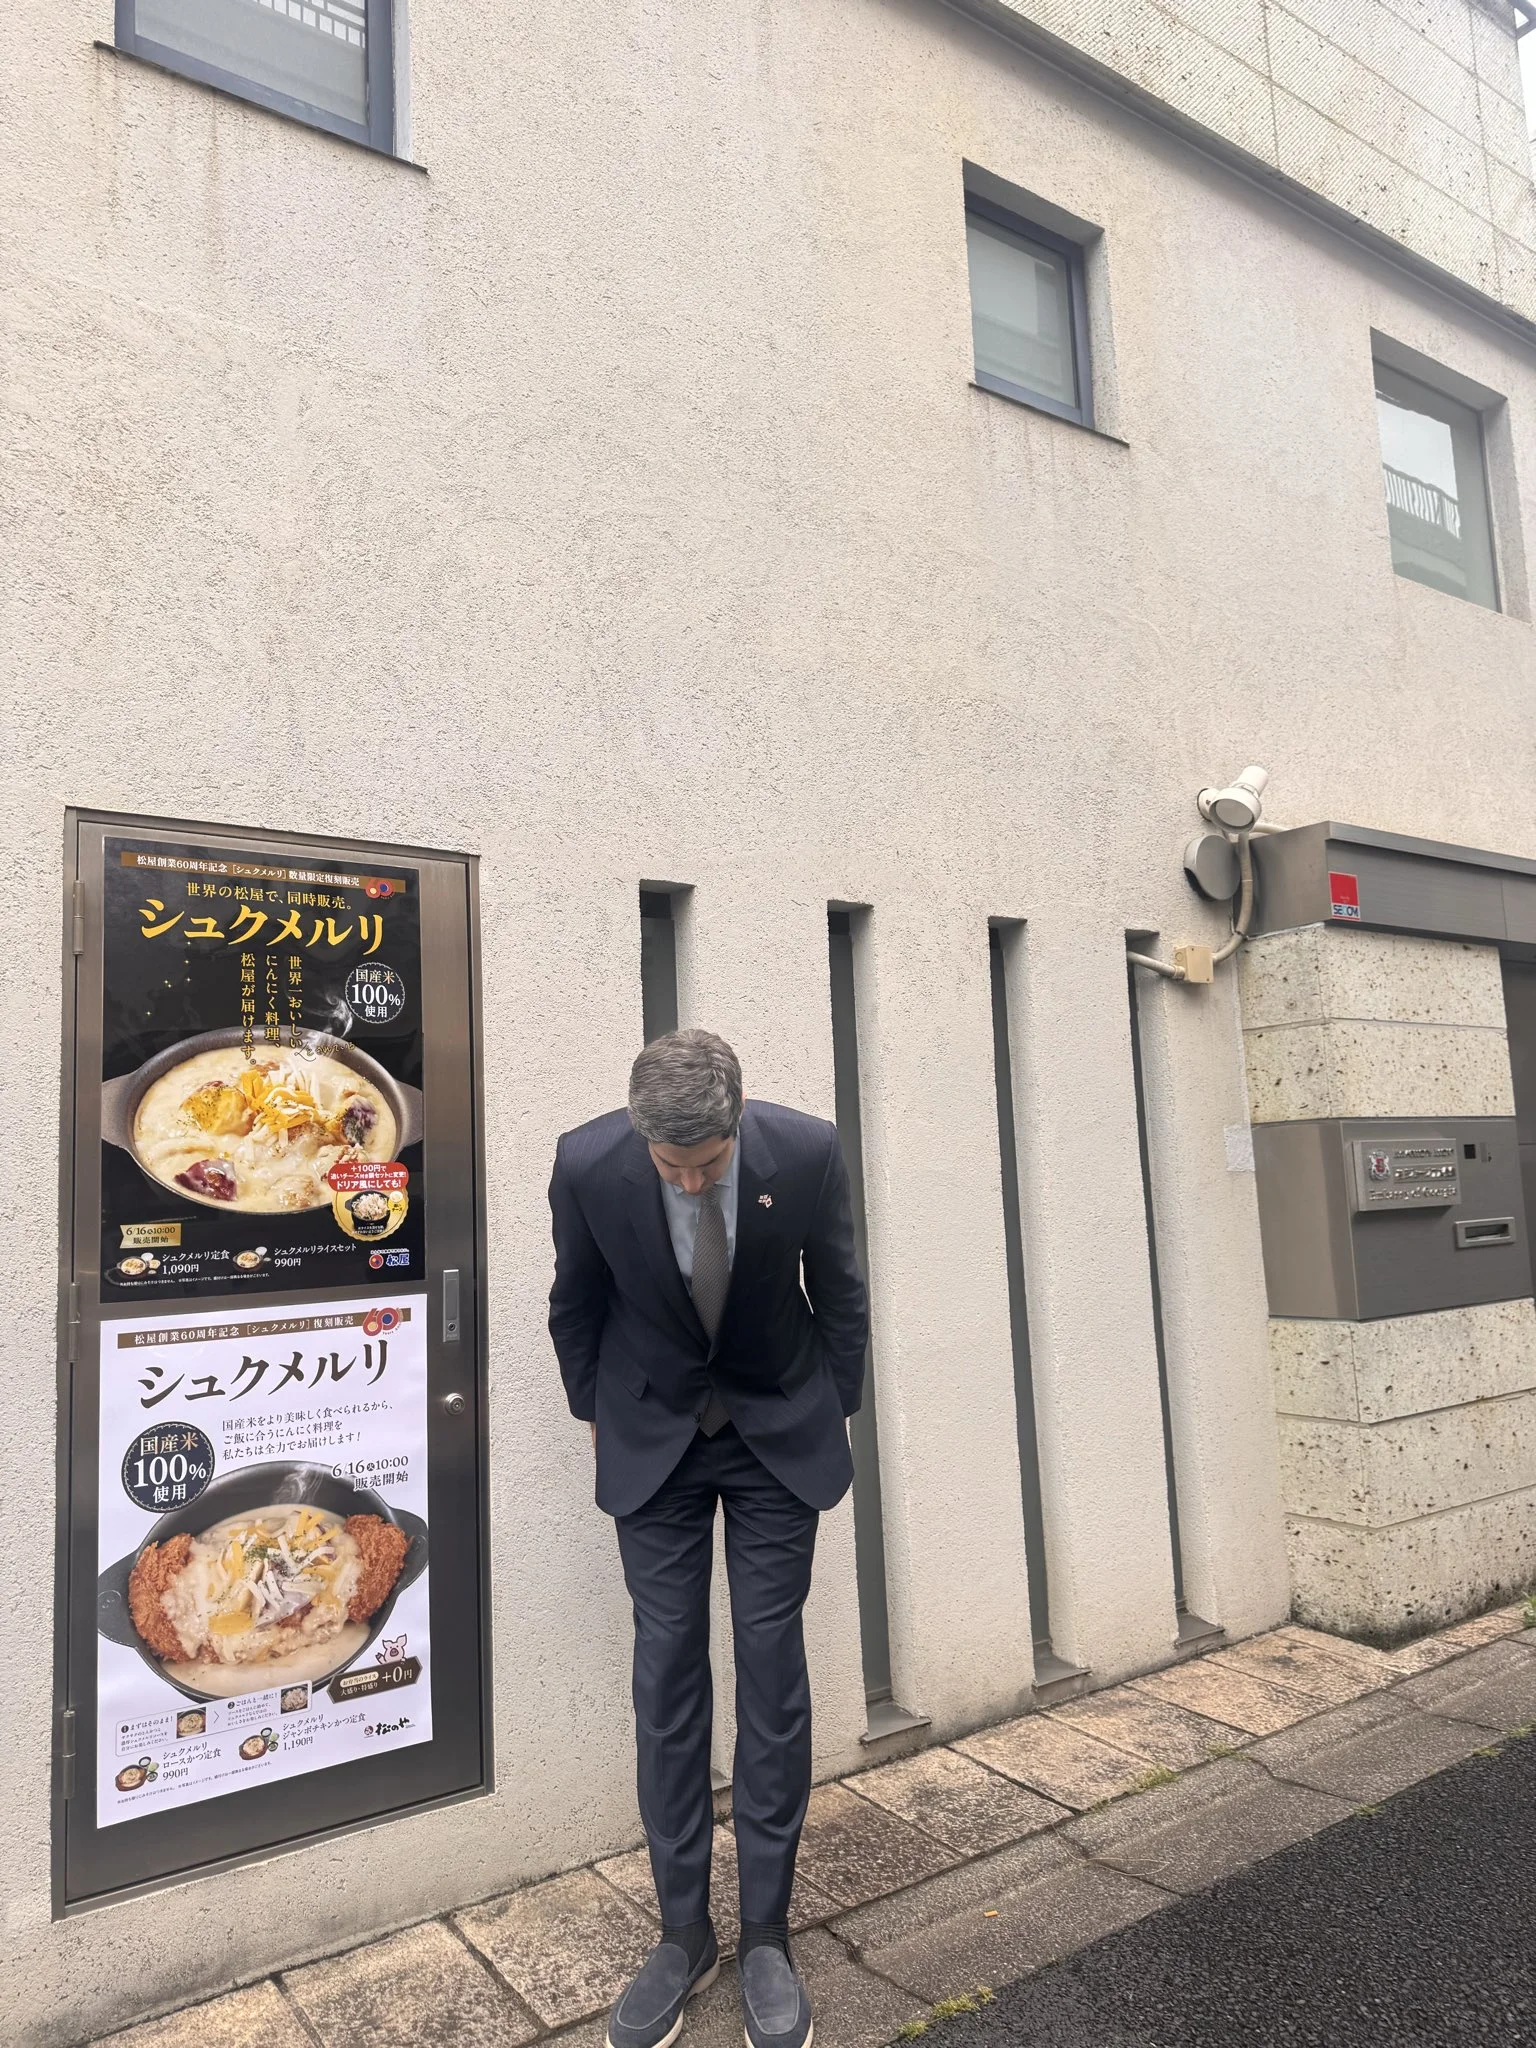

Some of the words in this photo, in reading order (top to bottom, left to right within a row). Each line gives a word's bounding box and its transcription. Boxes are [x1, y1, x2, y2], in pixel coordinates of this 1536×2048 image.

[186, 881, 353, 911] 世界の松屋で、同時販売。
[1332, 904, 1359, 918] SECOM
[138, 898, 384, 955] シュクメルリ
[355, 967, 395, 984] 国産米
[264, 954, 281, 1049] にんにく料理、
[287, 955, 303, 1049] 世界一おいしい
[351, 983, 401, 1007] 100%
[240, 952, 257, 1066] 松屋が届けます。
[364, 1005, 388, 1019] 使用
[336, 1179, 402, 1190] ドリア風にしても!
[132, 1236, 169, 1245] 販売開始
[274, 1243, 357, 1256] シュクメルリライスセット
[161, 1249, 230, 1262] シュクメルリ定食
[274, 1257, 301, 1268] 990円
[385, 1253, 410, 1267] 松屋
[161, 1263, 200, 1276] 1,090円
[137, 1339, 389, 1410] シュクメルリ
[221, 1400, 394, 1432] 国産米をより美味しく食べられるから、
[222, 1420, 343, 1446] ご飯に合うにんにく料理を
[139, 1431, 200, 1457] 国産米
[221, 1431, 362, 1461] 私たちは全力でお届けします!
[133, 1454, 207, 1488] 100%
[353, 1470, 410, 1492] 販売開始
[152, 1484, 187, 1504] 使用
[381, 1666, 413, 1683] +0円
[282, 1713, 324, 1732] シュクメルリ
[282, 1712, 366, 1740] ジャンボチキンかつ定食
[162, 1741, 208, 1761] シュクメルリ
[282, 1735, 314, 1751] 1,190円
[162, 1747, 222, 1769] ロースかつ定食
[162, 1767, 189, 1781] 990円
